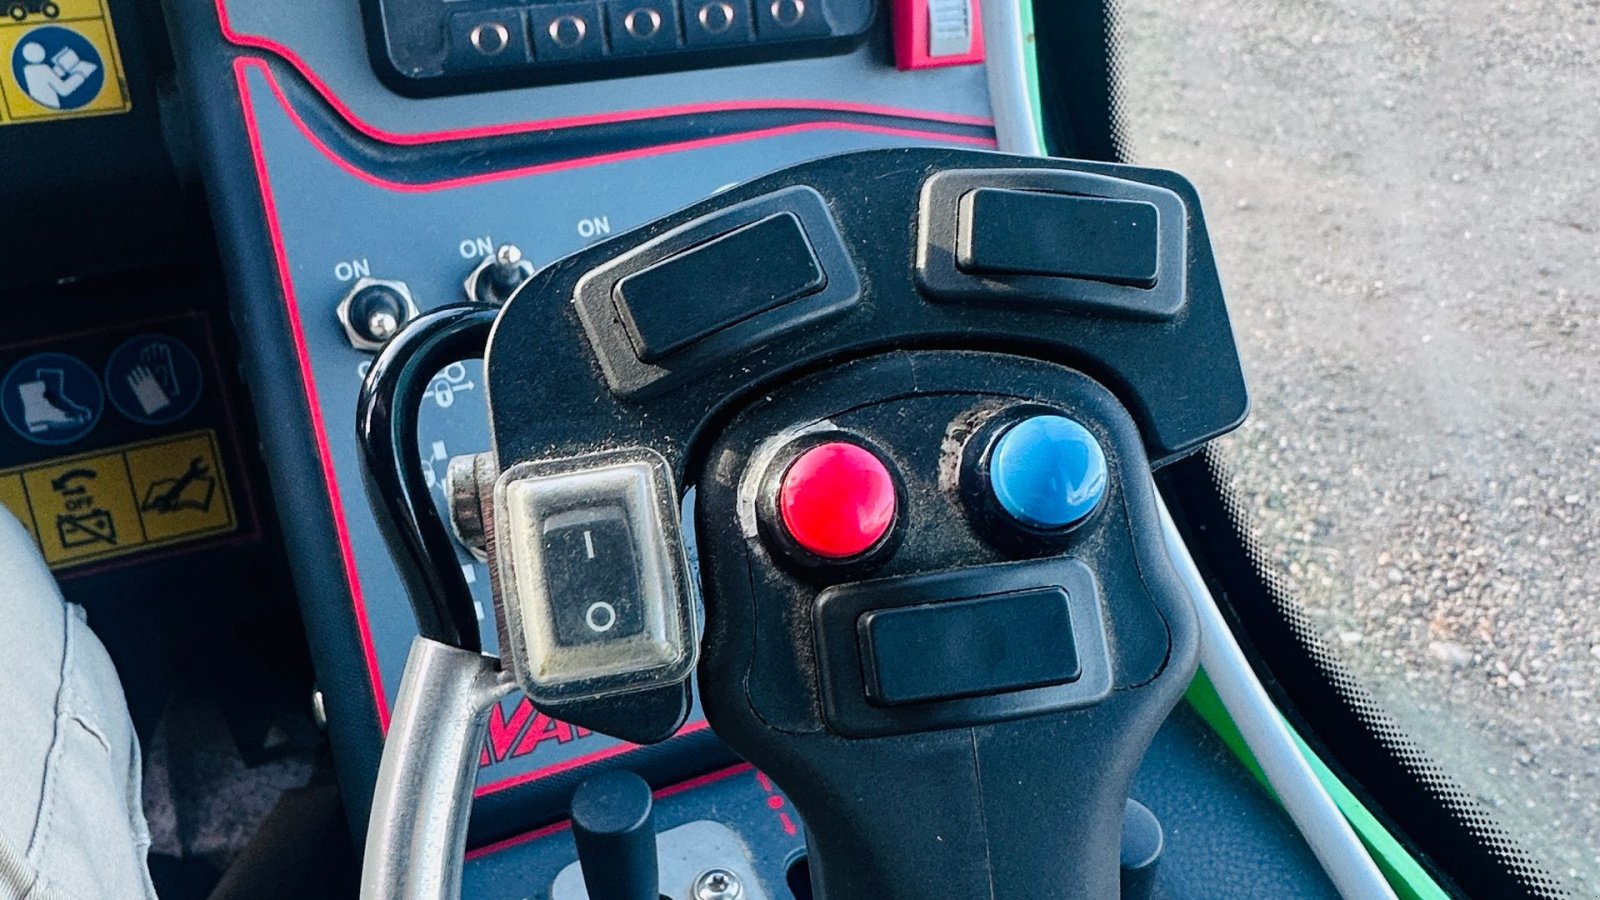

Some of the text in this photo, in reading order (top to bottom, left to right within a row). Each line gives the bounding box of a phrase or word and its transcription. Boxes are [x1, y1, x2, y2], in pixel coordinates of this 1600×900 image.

[577, 216, 611, 238] ON
[459, 236, 495, 260] ON
[334, 259, 371, 282] ON
